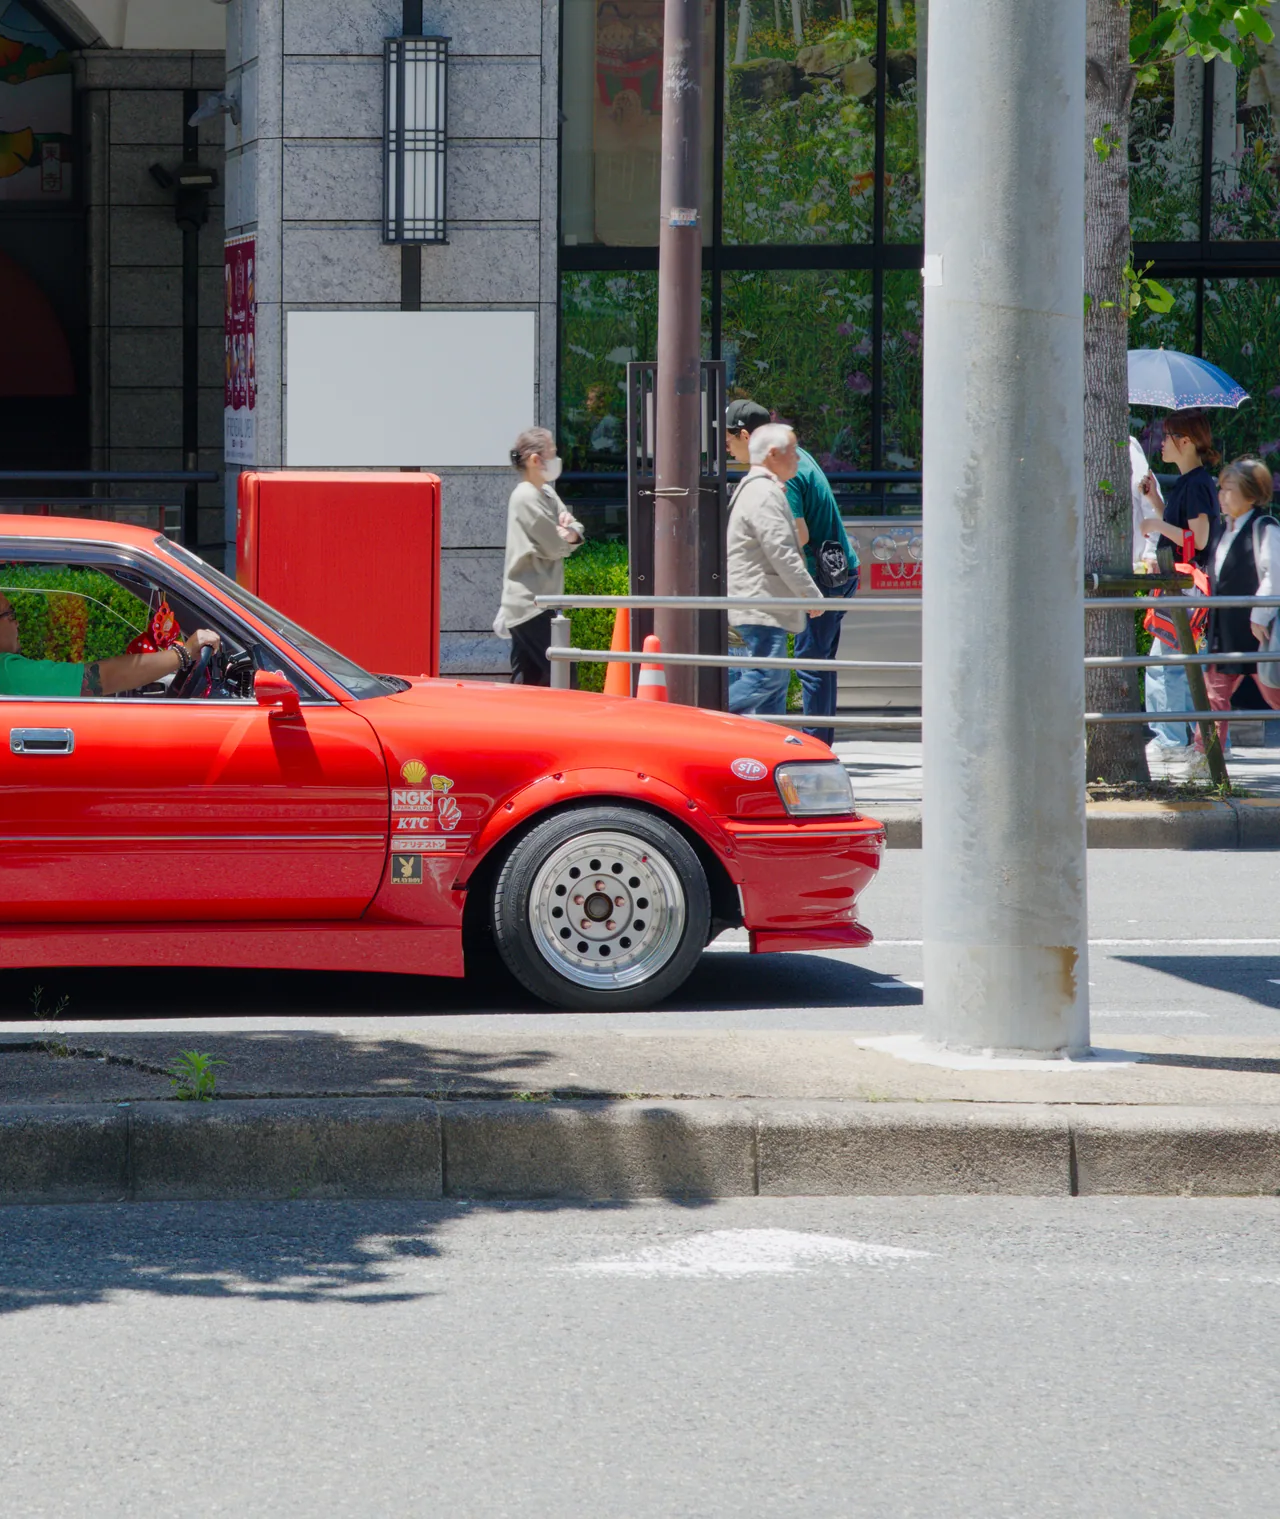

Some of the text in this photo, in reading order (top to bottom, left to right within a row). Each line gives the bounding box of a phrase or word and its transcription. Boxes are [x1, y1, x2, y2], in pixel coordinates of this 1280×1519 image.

[738, 762, 761, 775] STP
[393, 791, 432, 805] NGK
[397, 817, 429, 829] KTC
